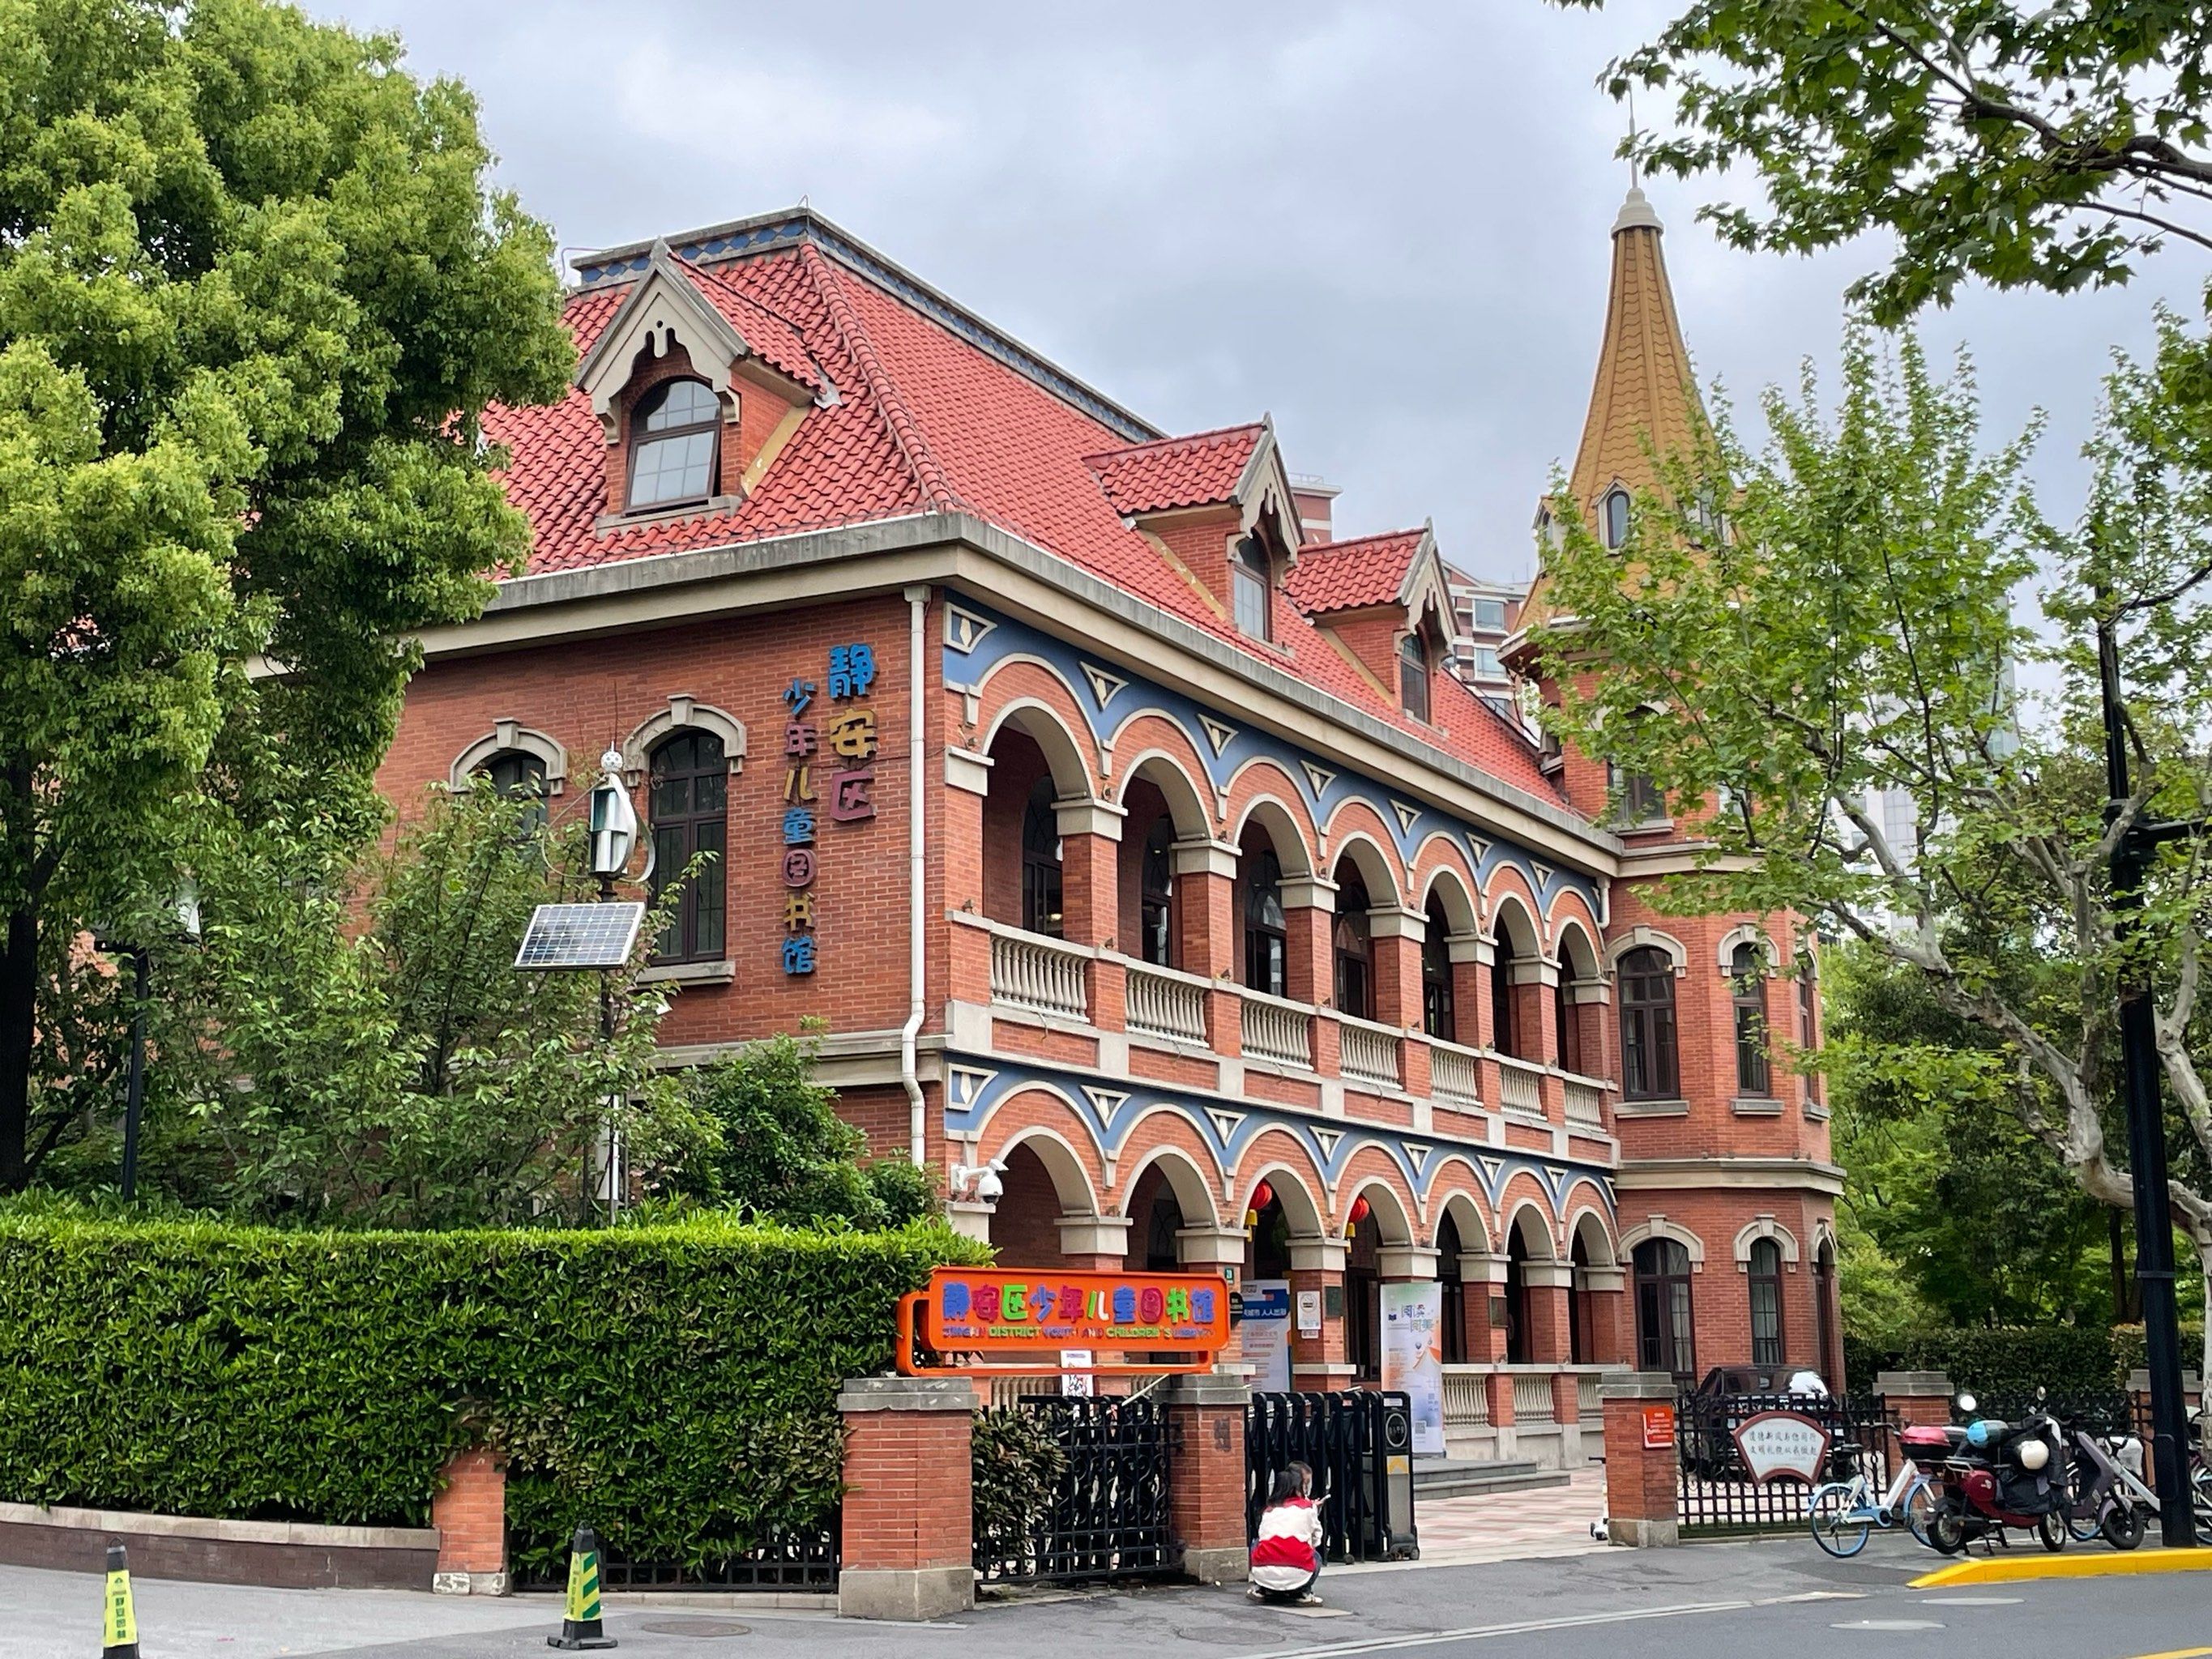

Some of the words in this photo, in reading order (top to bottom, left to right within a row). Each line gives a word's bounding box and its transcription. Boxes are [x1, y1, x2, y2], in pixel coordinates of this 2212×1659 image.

[827, 643, 878, 822] 静安区
[781, 677, 818, 975] 少年儿童图书馆
[942, 1282, 1215, 1324] 静安区少年儿童图书馆
[989, 1325, 1042, 1338] DISTRICT
[1081, 1327, 1105, 1338] AND
